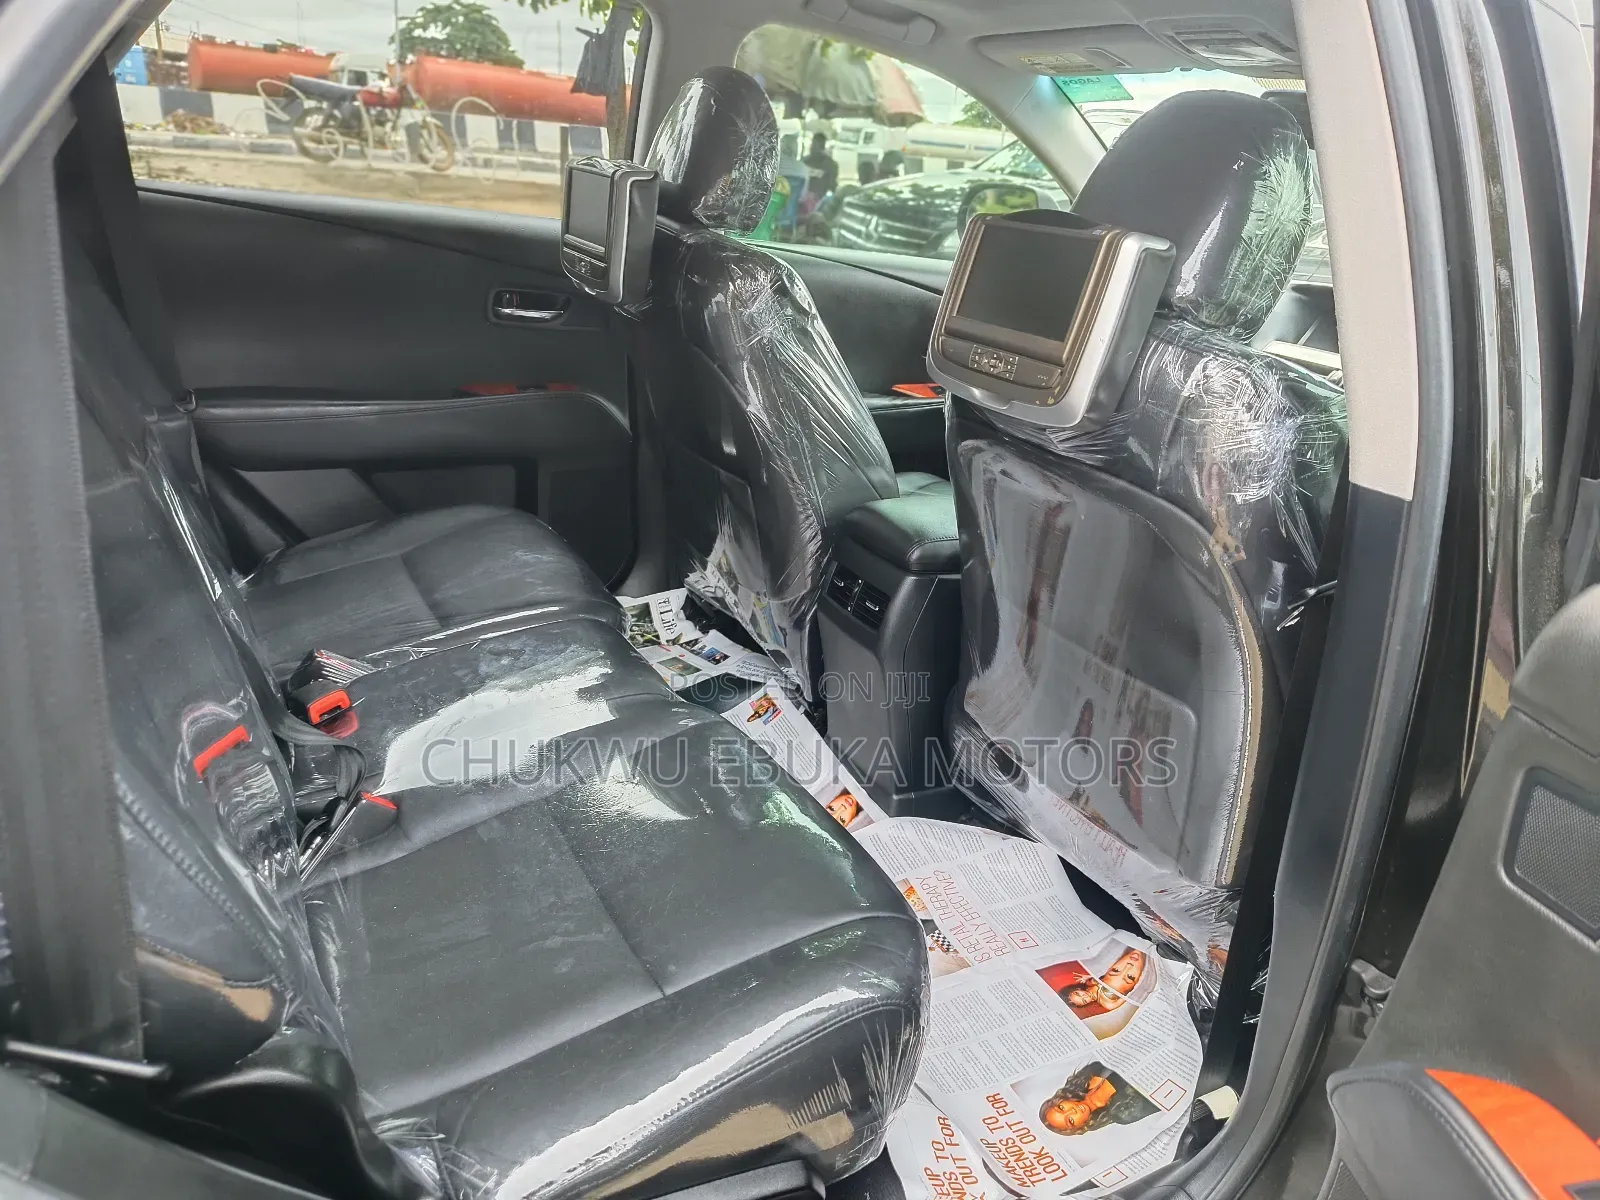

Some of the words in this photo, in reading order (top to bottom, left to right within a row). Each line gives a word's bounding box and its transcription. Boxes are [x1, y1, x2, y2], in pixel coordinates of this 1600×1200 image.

[916, 876, 956, 923] THERAPY
[933, 870, 981, 922] EFFECTIVE?
[970, 922, 1011, 957] REALLY
[985, 1092, 1015, 1117] FOR
[937, 1115, 960, 1146] FOR
[982, 1115, 1005, 1135] TO
[1005, 1120, 1037, 1145] OUT
[931, 1140, 950, 1164] TO
[980, 1138, 1031, 1188] MAKEUP
[998, 1137, 1046, 1187] TRENDS
[1028, 1146, 1068, 1182] LOOK
[950, 1153, 979, 1185] OUT
